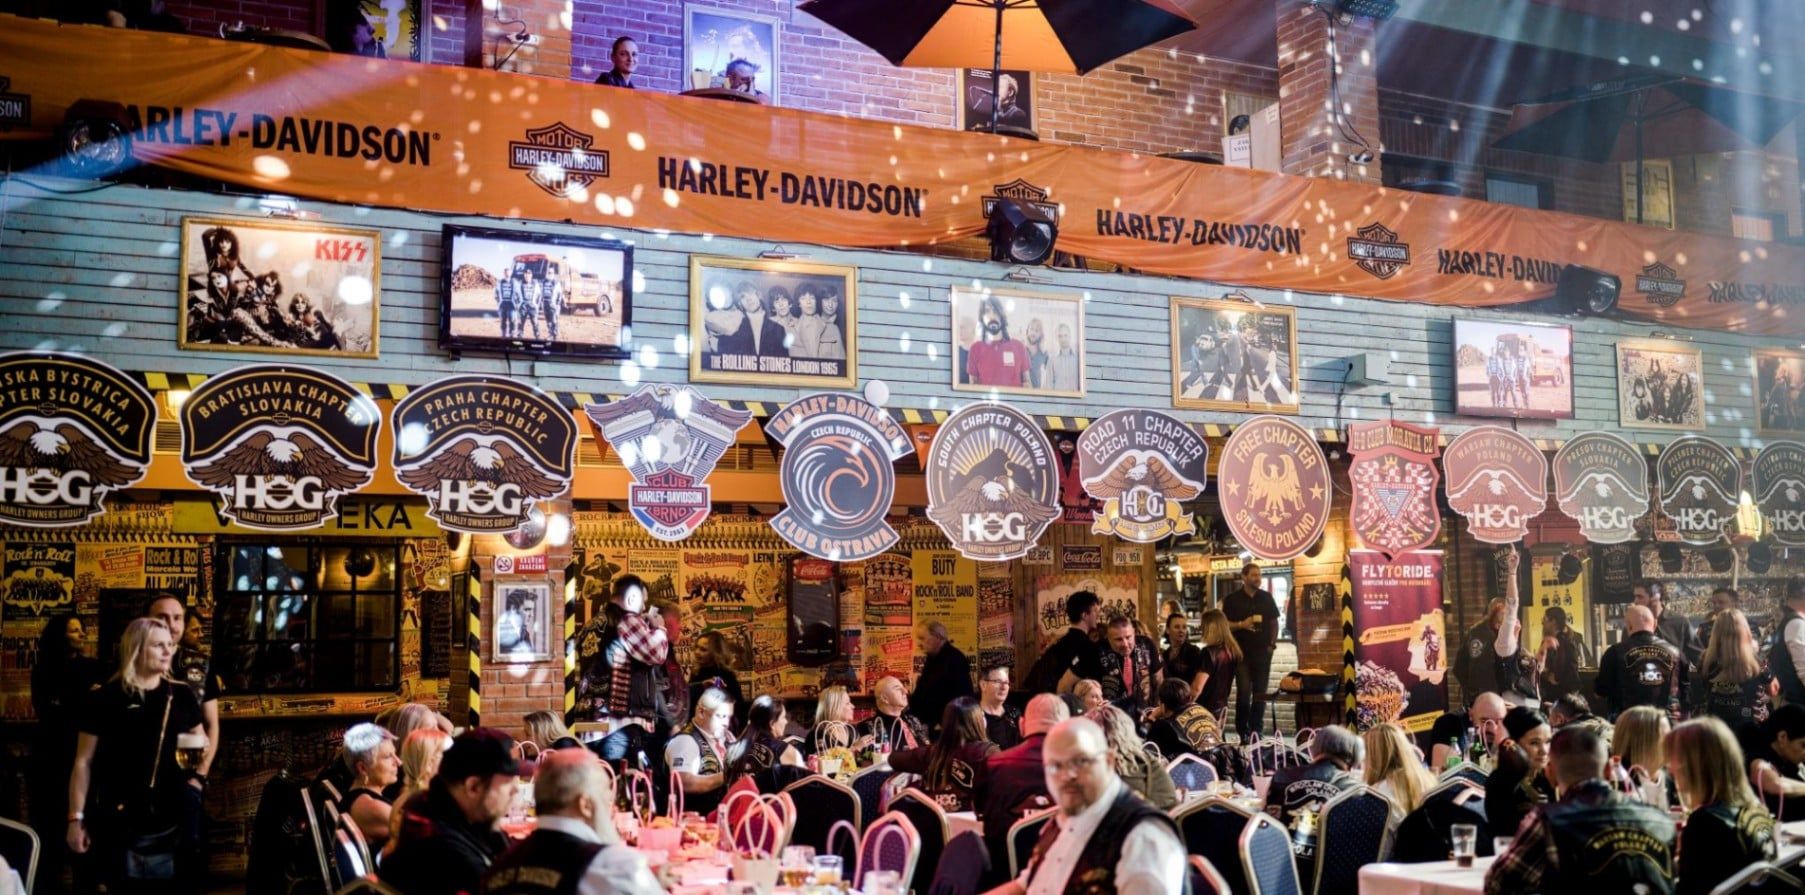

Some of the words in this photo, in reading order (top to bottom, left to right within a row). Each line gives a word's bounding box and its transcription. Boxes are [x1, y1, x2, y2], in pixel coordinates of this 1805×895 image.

[126, 104, 430, 166] ARLEY-DAVIDSON
[536, 130, 583, 148] MOTOR
[515, 148, 603, 171] HARLEY-DAVIDSON
[1002, 185, 1040, 201] MOTOR
[315, 239, 370, 263] KISS
[1438, 248, 1562, 284] HARLEY-DAVID
[711, 355, 721, 369] THE
[722, 354, 758, 371] ROLLING
[759, 356, 792, 373] STONES
[793, 360, 820, 374] LONDON
[821, 362, 838, 375] 1965
[0, 369, 39, 387] SKA
[47, 369, 131, 410] BYSTRICA
[49, 388, 131, 436] SLOVAKIA
[198, 381, 293, 419] BRATISLAVA
[298, 384, 364, 424] CHAPTER
[239, 399, 323, 420] SLOVAKIA
[424, 391, 476, 416] PRAHA
[481, 391, 550, 425] CHAPTER
[424, 408, 470, 435] CZECH
[475, 407, 549, 445] REPUBLIC
[772, 396, 907, 449] HARLEY-DAVIDSON
[810, 426, 834, 438] CZECH
[836, 425, 872, 446] REPUBLIC
[938, 428, 960, 468] SOUTH
[961, 412, 1012, 431] CHAPTER
[1014, 422, 1047, 466] POLAND
[1082, 420, 1116, 456] ROAD
[1122, 415, 1136, 431] 11
[1145, 416, 1204, 460] CHAPTER
[1094, 433, 1129, 465] CZECH
[1135, 432, 1191, 469] REPUBLIK
[1234, 428, 1263, 463] FREE
[1263, 426, 1317, 470] CHAPTER
[1494, 440, 1533, 464] CHAPTER
[1596, 443, 1632, 464] CHAPTER
[1696, 448, 1729, 469] CHAPTER
[1580, 454, 1619, 469] SLOVAKIA
[1670, 460, 1690, 479] CZECH
[1691, 459, 1727, 481] REPUBLIC
[234, 474, 324, 510] HOG
[652, 474, 688, 488] CLUB
[439, 479, 523, 516] HOG
[637, 490, 703, 504] HARLEY-DAVIDSON
[27, 508, 58, 519] OWNERS
[59, 507, 83, 518] GROUP
[241, 511, 266, 523] HARLEY
[266, 513, 294, 524] OWNERS
[294, 512, 317, 523] GROUP
[445, 515, 467, 526] HARLEY
[468, 517, 494, 528] OWNERS
[494, 516, 516, 527] GROUP
[653, 507, 687, 523] BRNO
[1473, 504, 1520, 528] HOG
[1583, 507, 1628, 529] HOG
[1680, 508, 1718, 530] HOG
[778, 515, 818, 550] CLUB
[820, 527, 893, 556] OSTRAVA
[961, 512, 1026, 542] HOG
[1236, 509, 1273, 549] SILESIA
[1275, 512, 1316, 549] POLAND
[147, 549, 171, 564] Rock
[932, 559, 956, 575] BUTY
[956, 585, 974, 597] BAND
